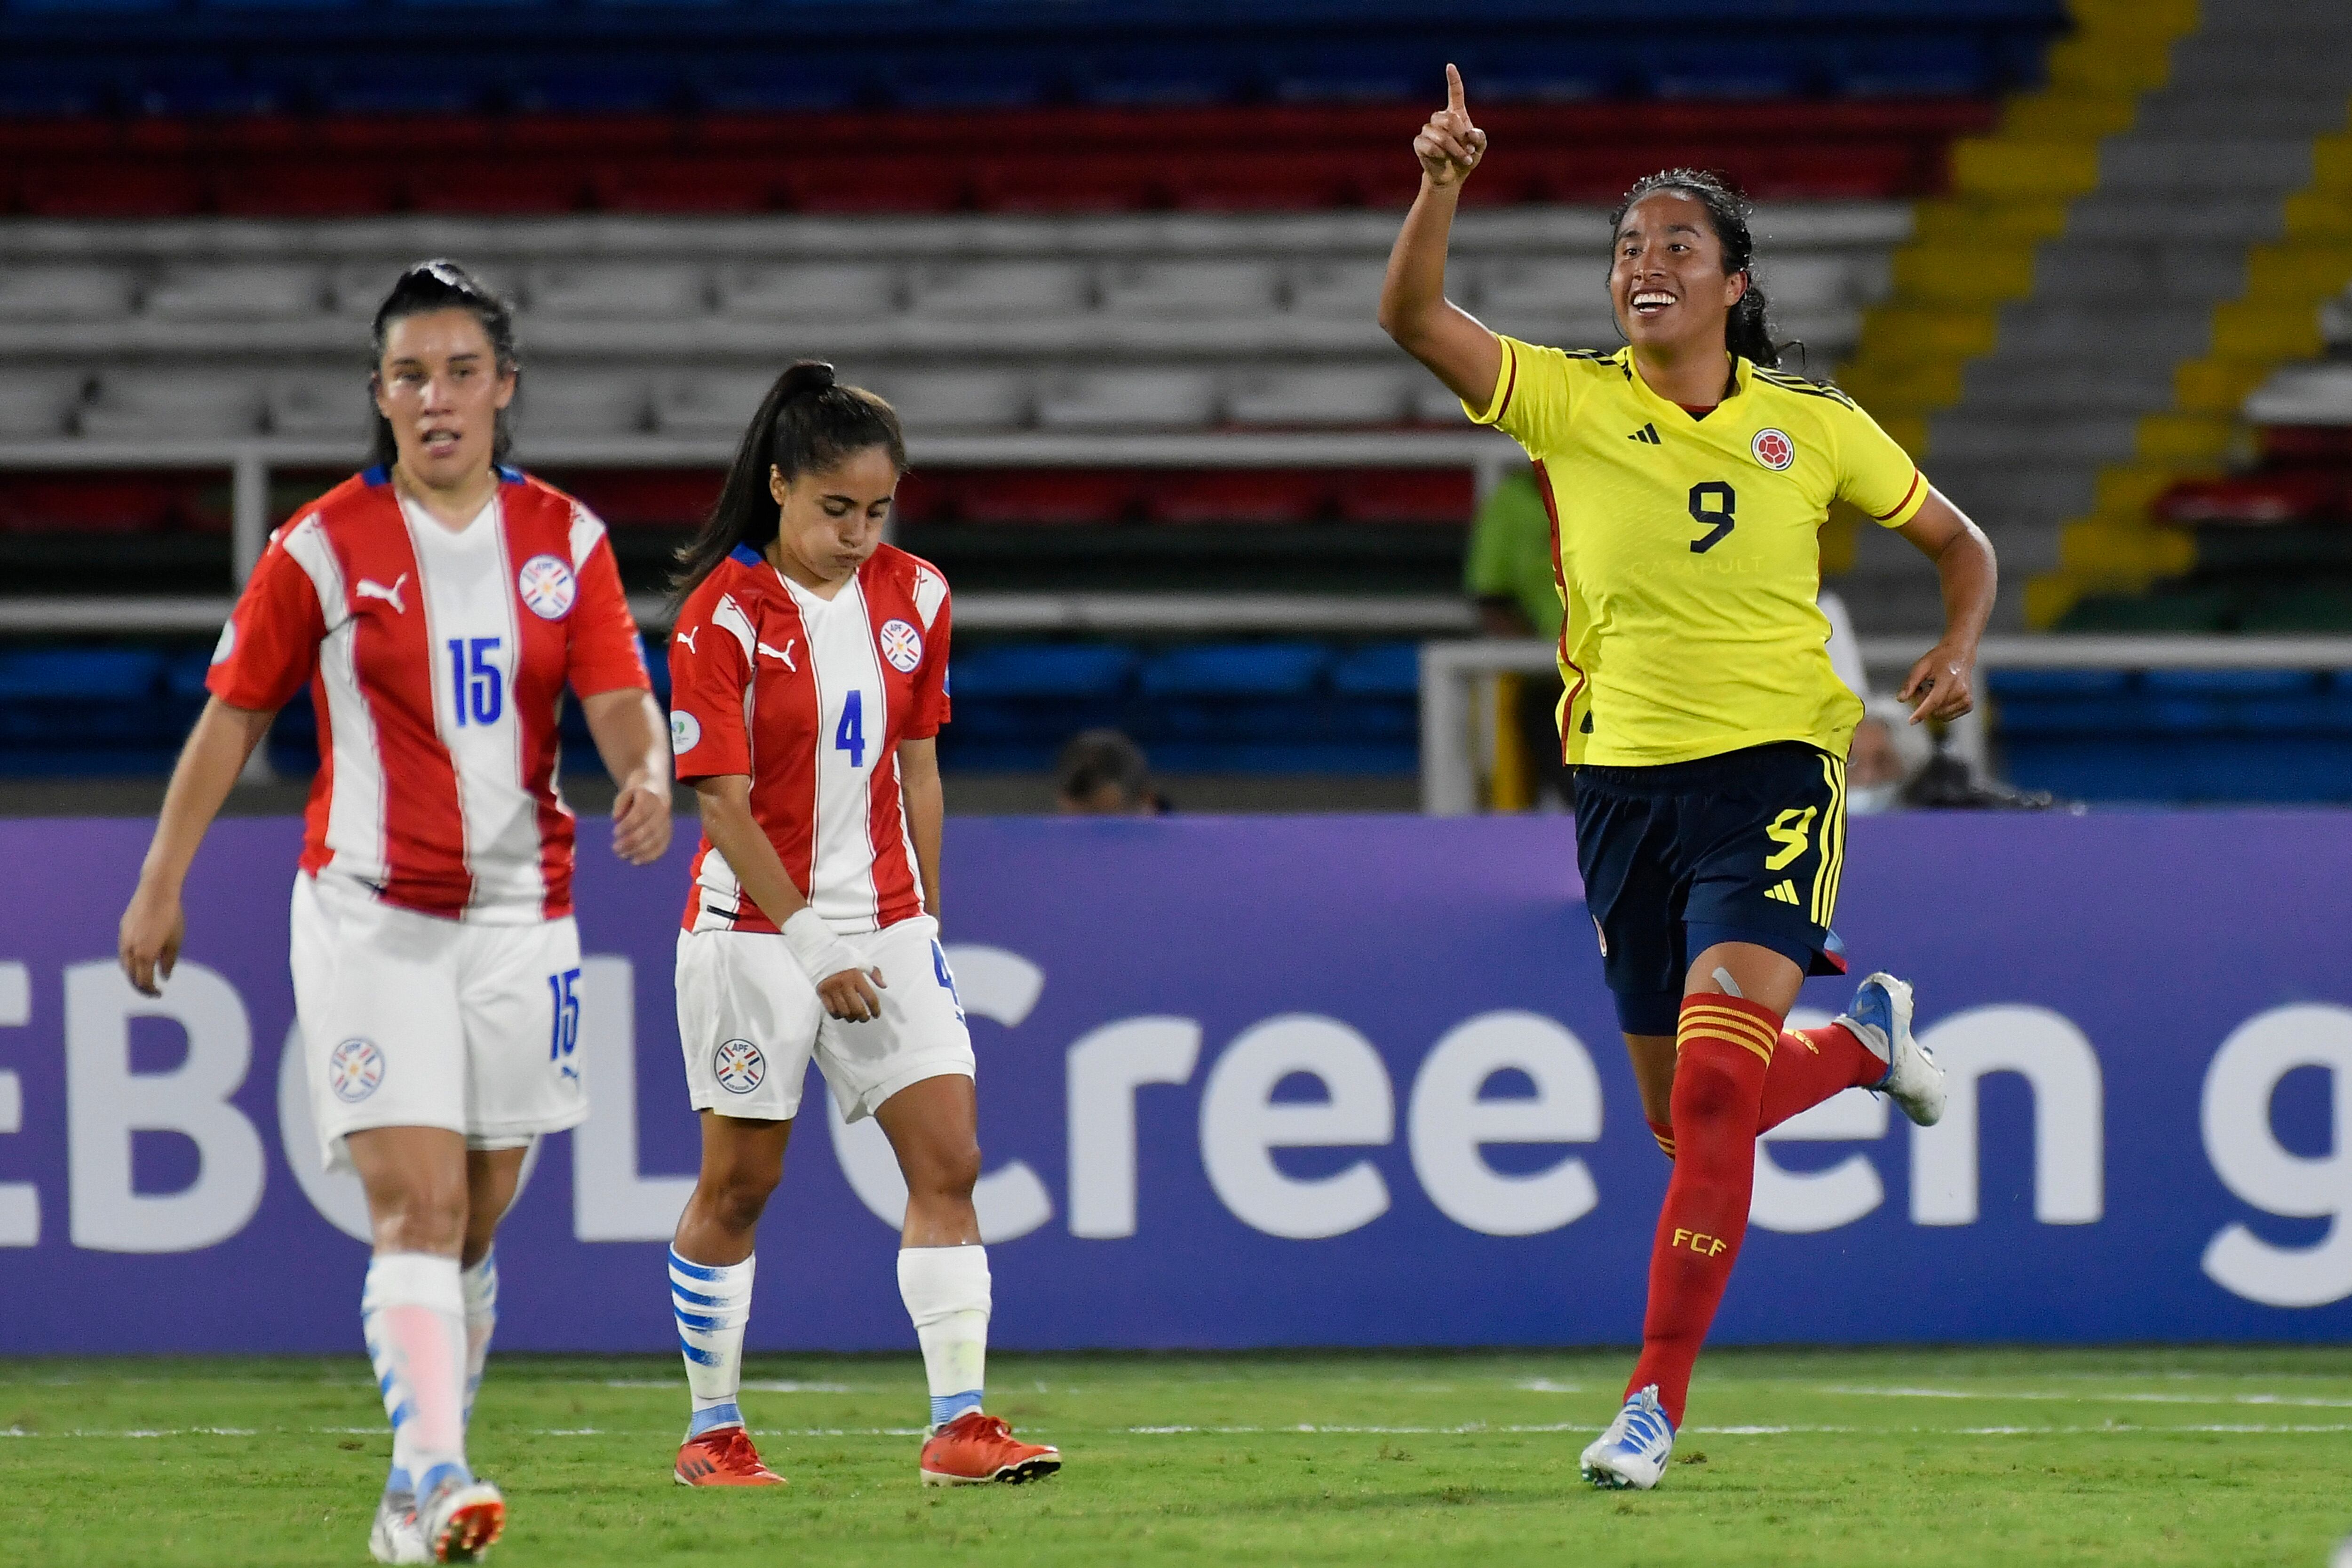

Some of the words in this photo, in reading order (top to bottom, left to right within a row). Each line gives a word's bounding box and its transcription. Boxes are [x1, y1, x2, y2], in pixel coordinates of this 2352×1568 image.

[1688, 481, 1736, 554] 9
[448, 637, 502, 727] 15
[835, 689, 866, 768] 4
[1765, 805, 1817, 870] 9
[549, 968, 581, 1061] 15
[732, 1043, 748, 1053] APF
[1672, 1227, 1727, 1258] FCF
